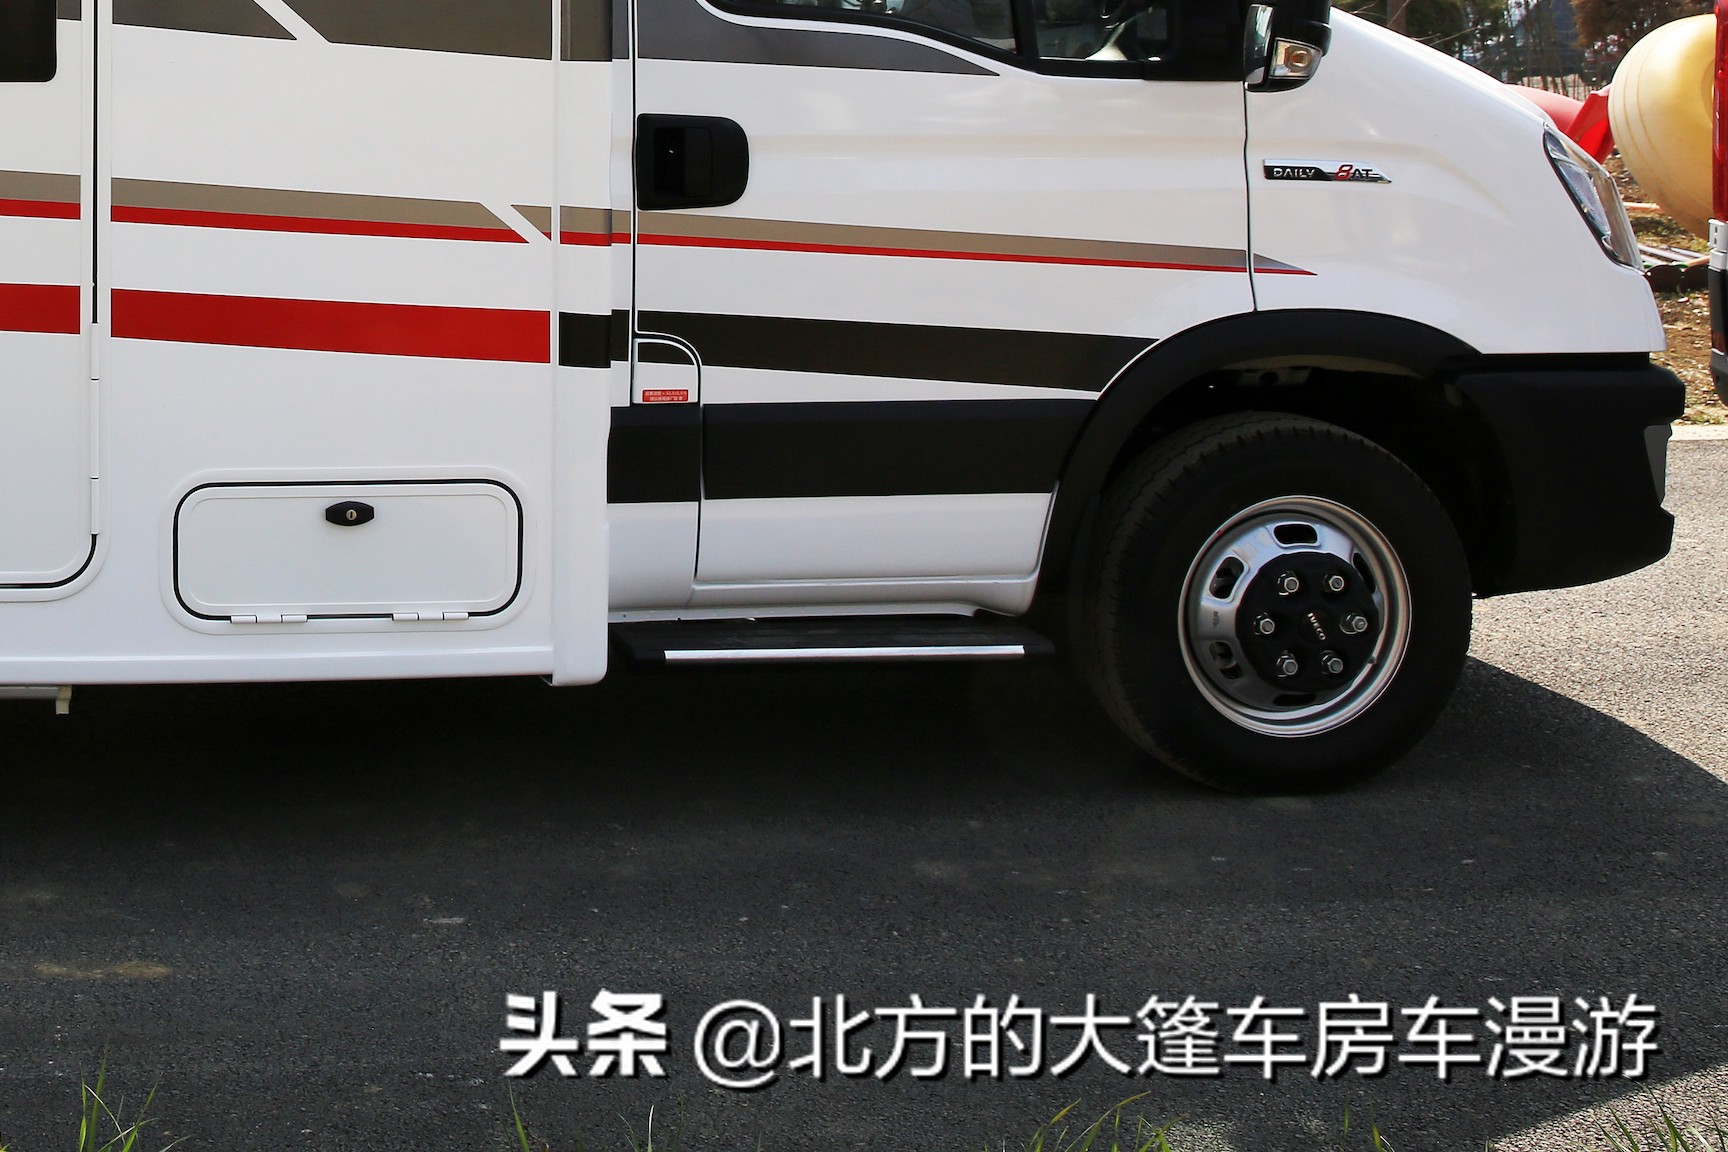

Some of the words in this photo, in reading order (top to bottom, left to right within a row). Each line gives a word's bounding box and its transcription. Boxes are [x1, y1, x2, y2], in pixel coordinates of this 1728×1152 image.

[1273, 168, 1315, 178] DAILY
[1335, 164, 1373, 181] 8AT
[1307, 612, 1325, 640] IVECO
